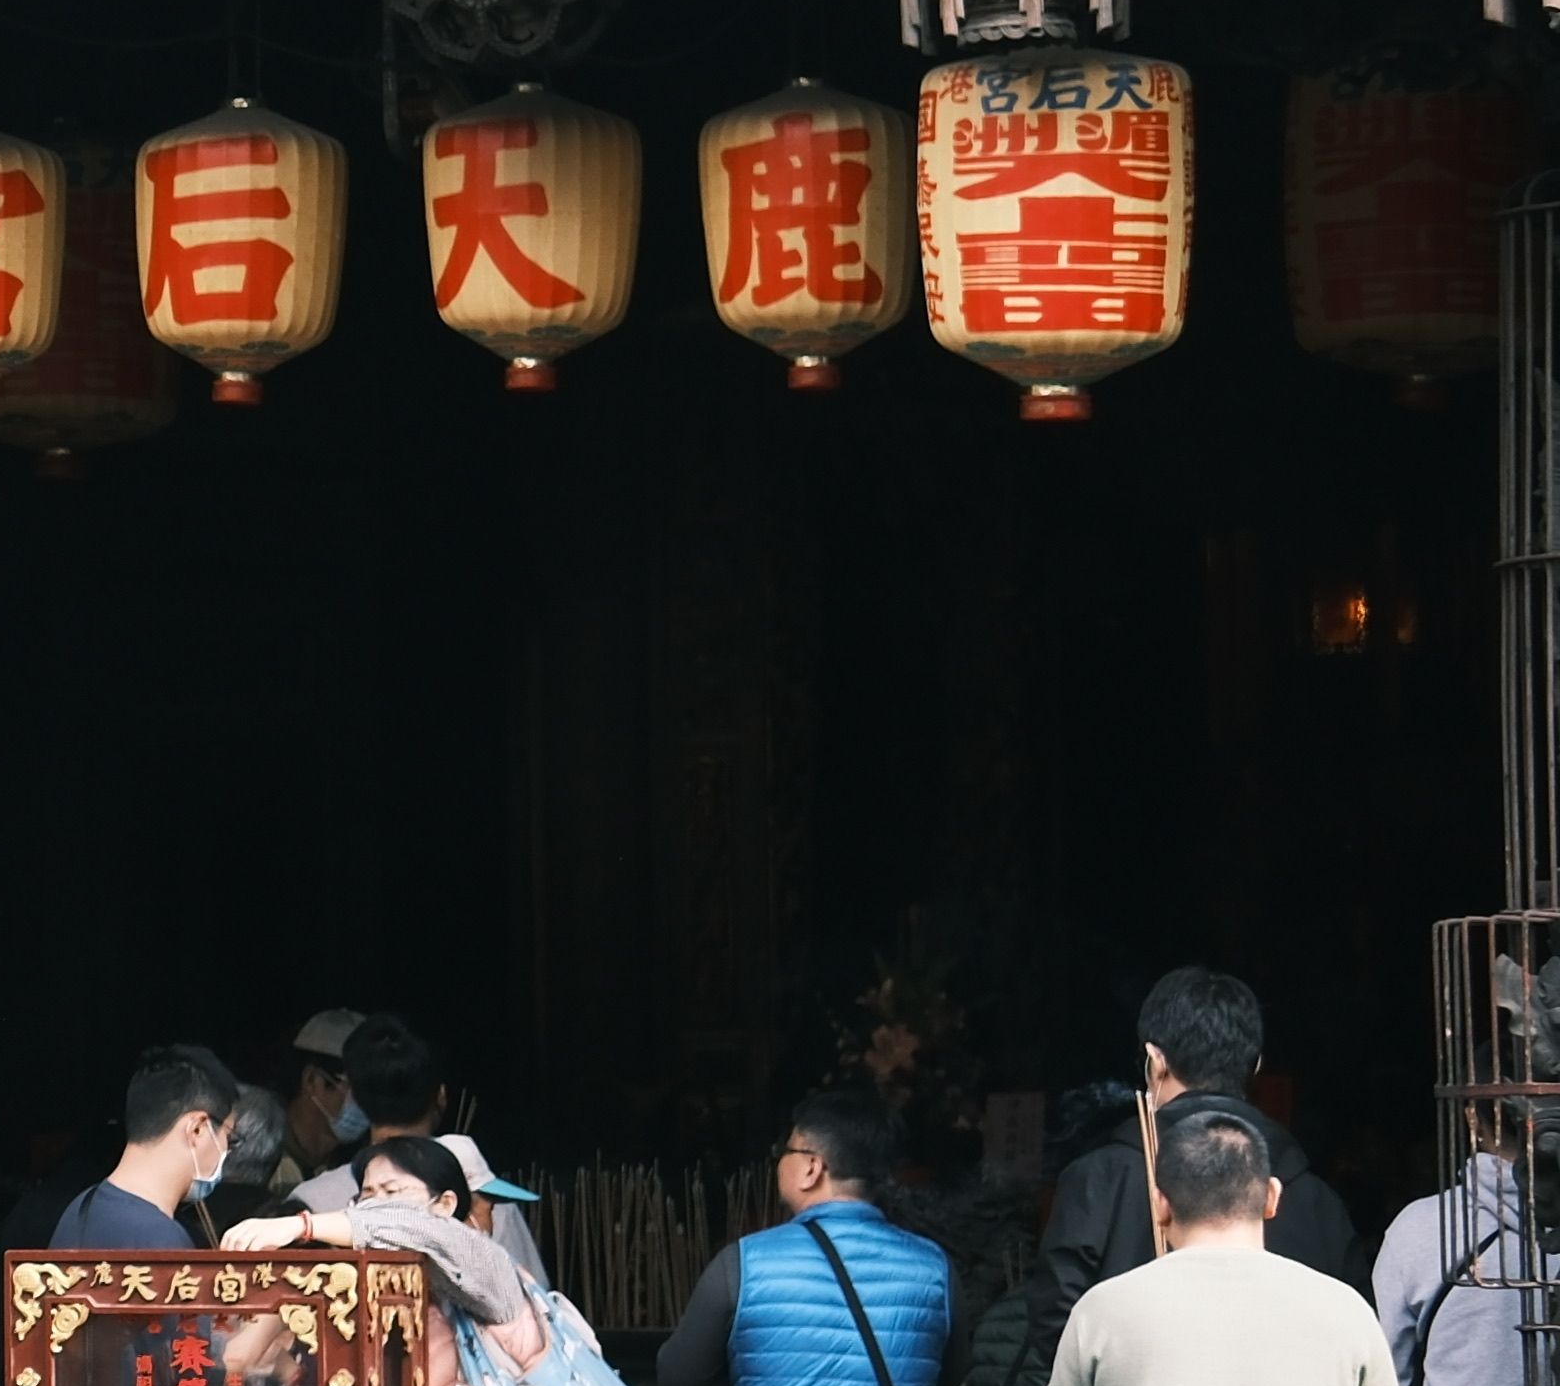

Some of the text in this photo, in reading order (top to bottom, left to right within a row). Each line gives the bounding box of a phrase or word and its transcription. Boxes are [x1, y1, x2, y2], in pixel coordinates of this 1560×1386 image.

[143, 134, 294, 326] 后
[432, 119, 586, 310] 天
[718, 113, 883, 307] 鹿
